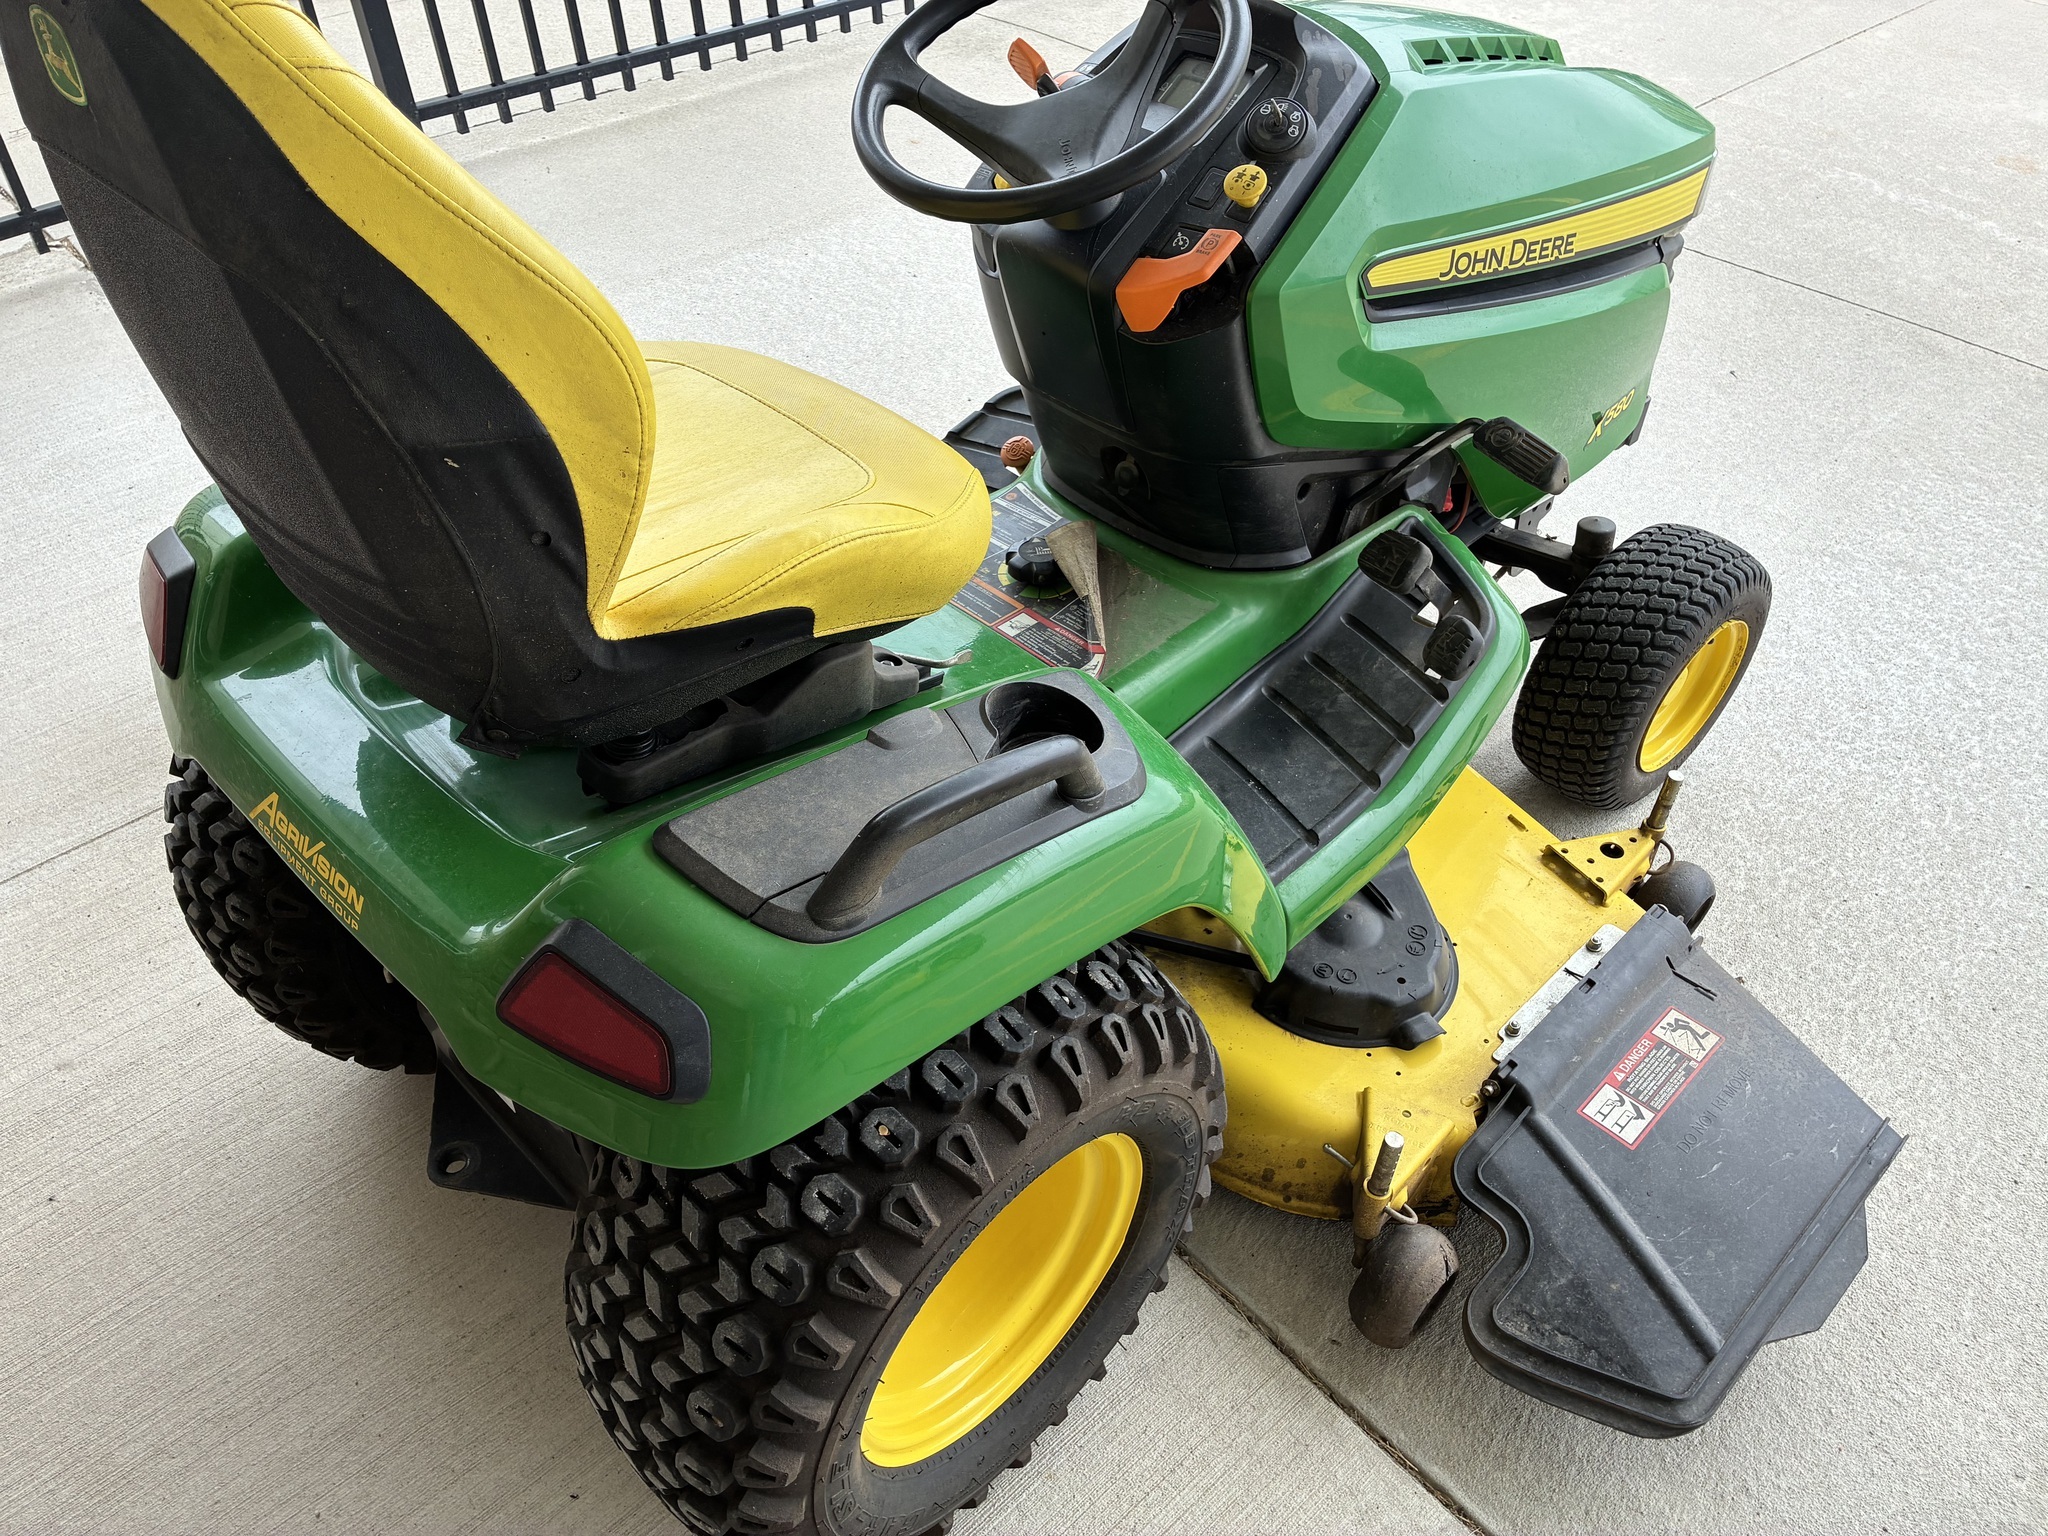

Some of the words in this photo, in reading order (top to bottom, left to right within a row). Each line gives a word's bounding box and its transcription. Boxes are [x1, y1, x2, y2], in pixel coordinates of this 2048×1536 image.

[1439, 247, 1505, 279] JOHN
[1509, 233, 1577, 271] DEERE
[1584, 387, 1636, 451] X580
[1059, 627, 1084, 646] DANGER
[258, 819, 316, 886] EQUIPMENT
[320, 886, 359, 930] GROUP
[1620, 1038, 1653, 1073] DANGER
[1625, 1060, 1647, 1083] ROTATING
[1642, 1047, 1658, 1063] BLADE
[1638, 1071, 1657, 1091] THROWN
[1652, 1054, 1672, 1074] OBJECTS
[1677, 1133, 1698, 1155] DO
[1696, 1110, 1718, 1136] NOT
[1715, 1068, 1750, 1111] REMOVE
